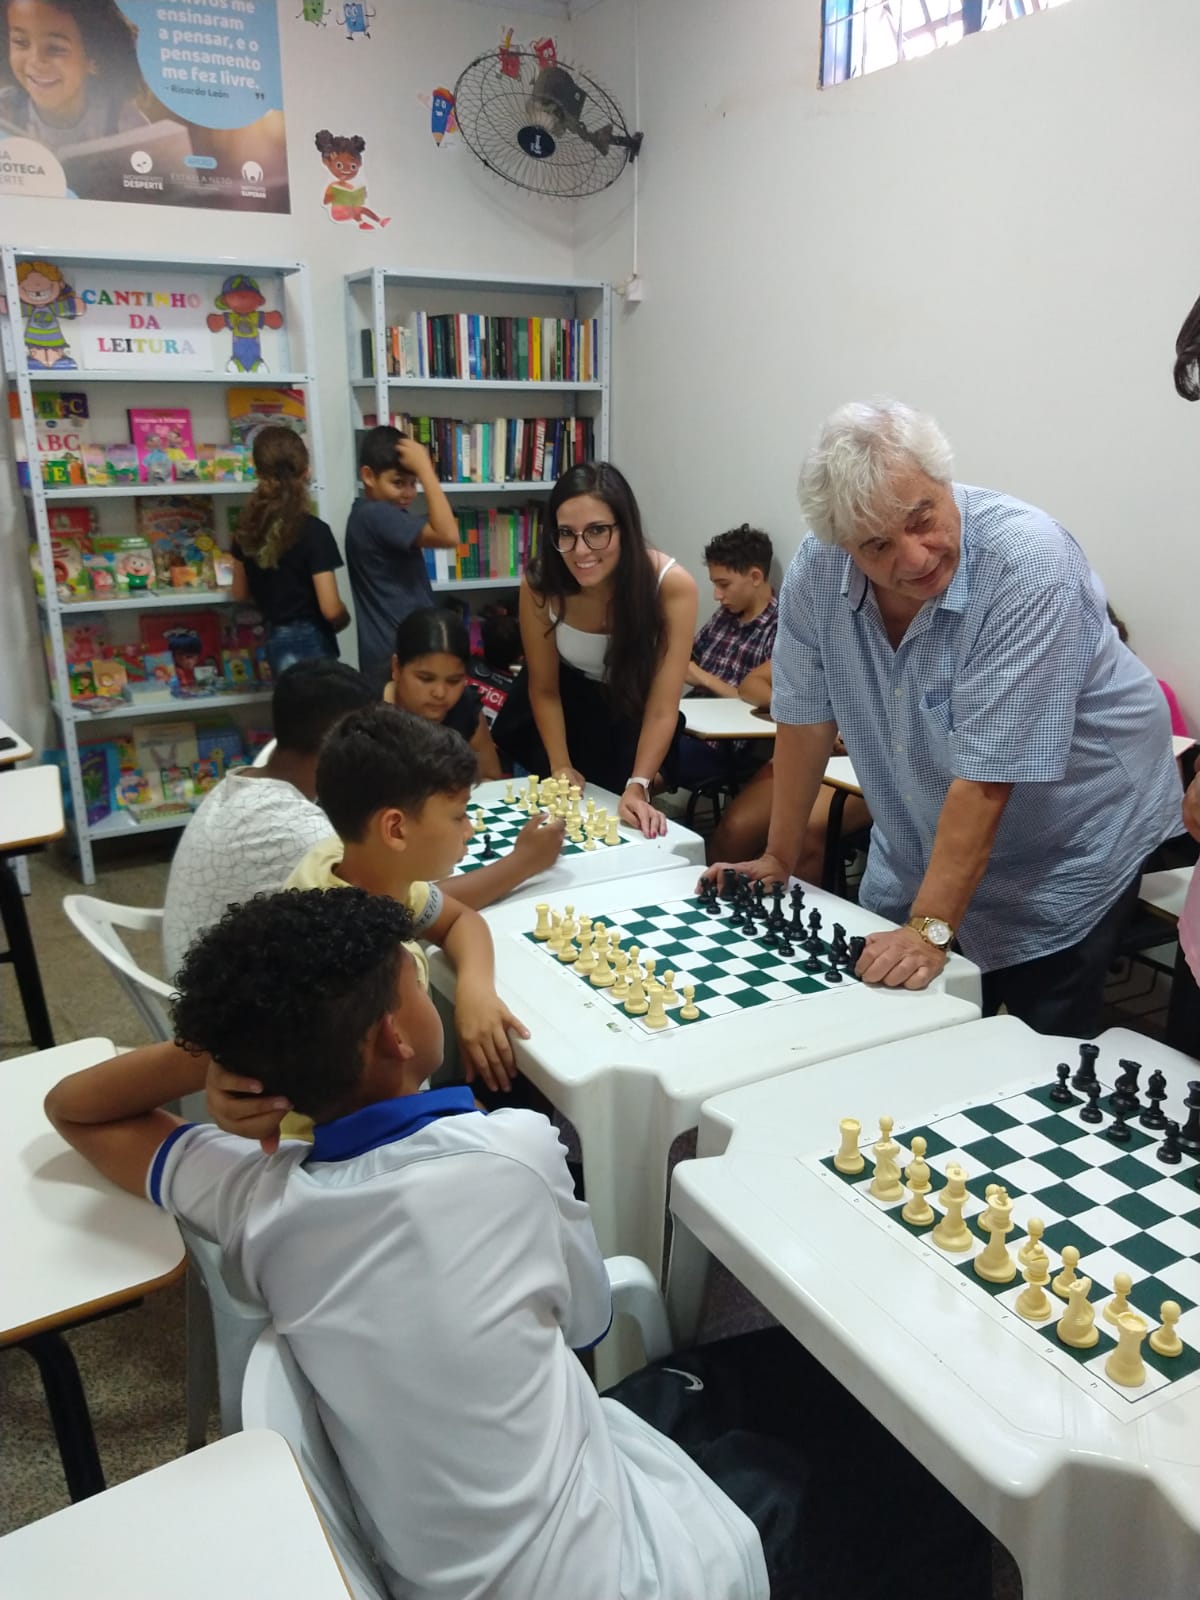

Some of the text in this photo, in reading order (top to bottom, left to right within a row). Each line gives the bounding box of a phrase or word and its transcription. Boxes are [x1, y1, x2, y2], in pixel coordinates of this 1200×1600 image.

[231, 1, 255, 13] me
[157, 8, 244, 30] ensinaram
[158, 28, 259, 52] a pensar, e o
[160, 47, 261, 71] pensamento
[162, 66, 260, 89] me fez livre.
[123, 180, 164, 191] DESPERTE
[81, 289, 202, 308] CANTINHO
[129, 314, 161, 330] DA
[97, 337, 196, 354] LEITURA
